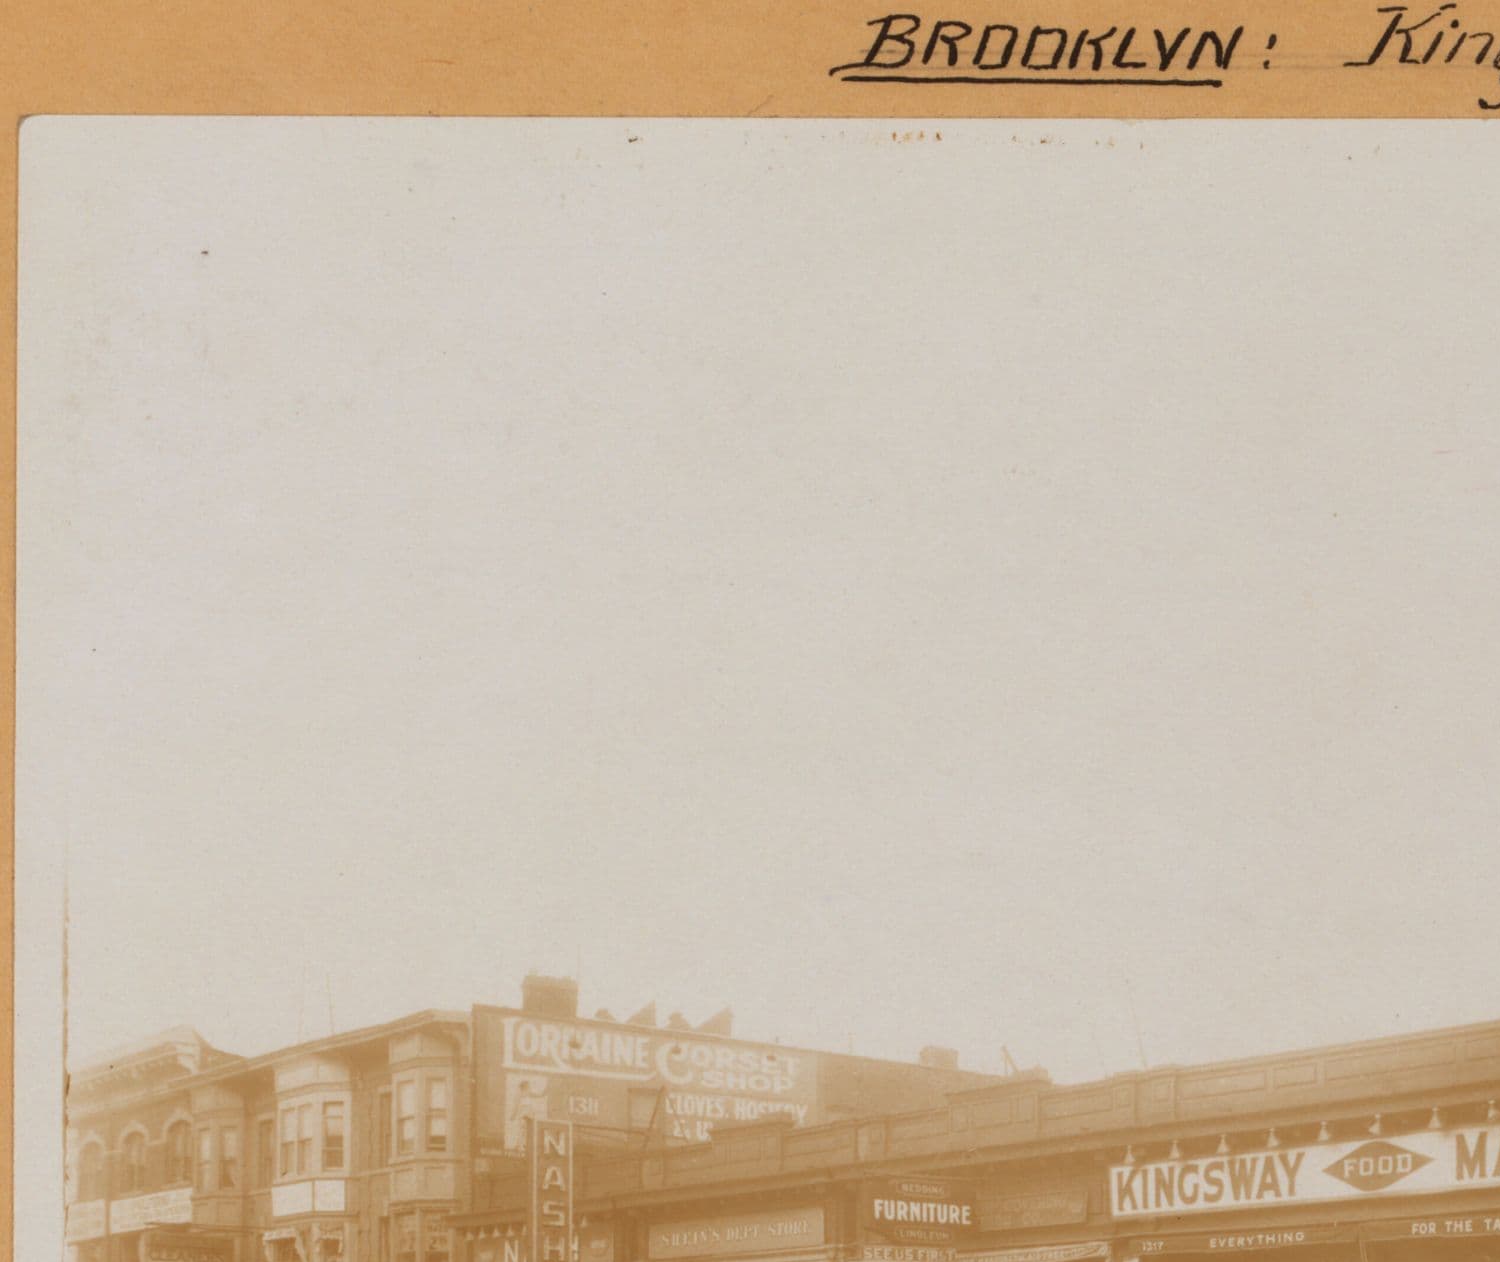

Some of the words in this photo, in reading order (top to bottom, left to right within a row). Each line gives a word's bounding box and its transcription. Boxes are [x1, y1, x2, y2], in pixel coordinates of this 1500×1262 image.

[656, 1041, 801, 1086] CORSET
[701, 1069, 796, 1094] SHOP
[542, 1128, 568, 1262] NASH
[1117, 1151, 1306, 1214] KINGSWAY
[1342, 1152, 1413, 1178] FOOD
[872, 1198, 972, 1226] FURNITURE
[1208, 1230, 1306, 1249] EVERYTHING
[1410, 1222, 1437, 1236] FOR
[1445, 1219, 1474, 1234] THE
[897, 1247, 915, 1261] US
